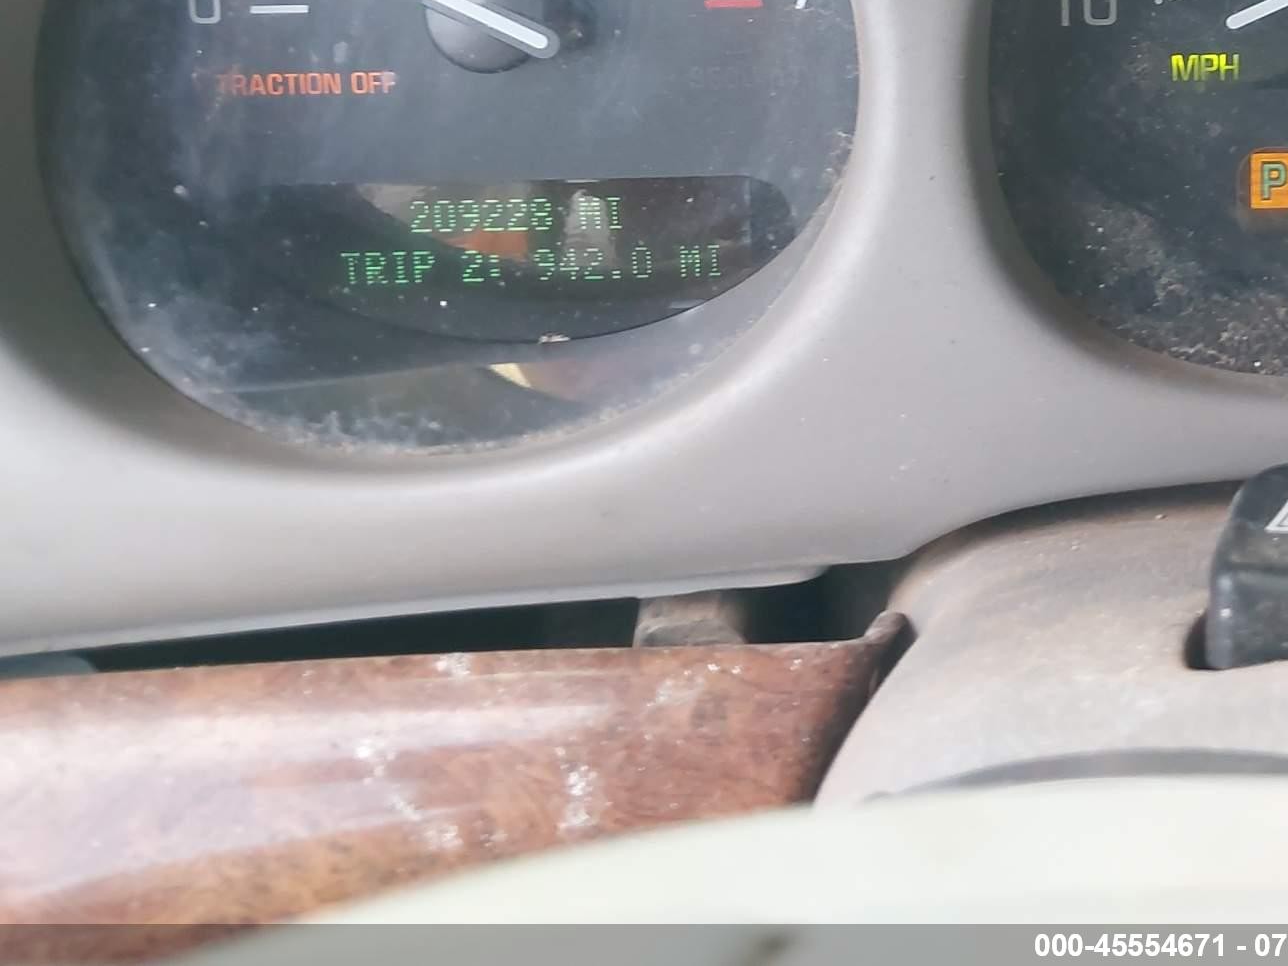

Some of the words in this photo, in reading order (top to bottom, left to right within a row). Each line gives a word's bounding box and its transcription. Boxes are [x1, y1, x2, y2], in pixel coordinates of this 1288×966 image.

[216, 72, 342, 96] TRACTION
[350, 71, 397, 95] OFF
[1170, 52, 1239, 81] MPH
[1260, 161, 1288, 201] P
[409, 198, 553, 232] 209228
[577, 196, 623, 230] MI
[340, 250, 435, 285] TRIP
[532, 245, 653, 281] 942.0
[679, 244, 722, 278] MI
